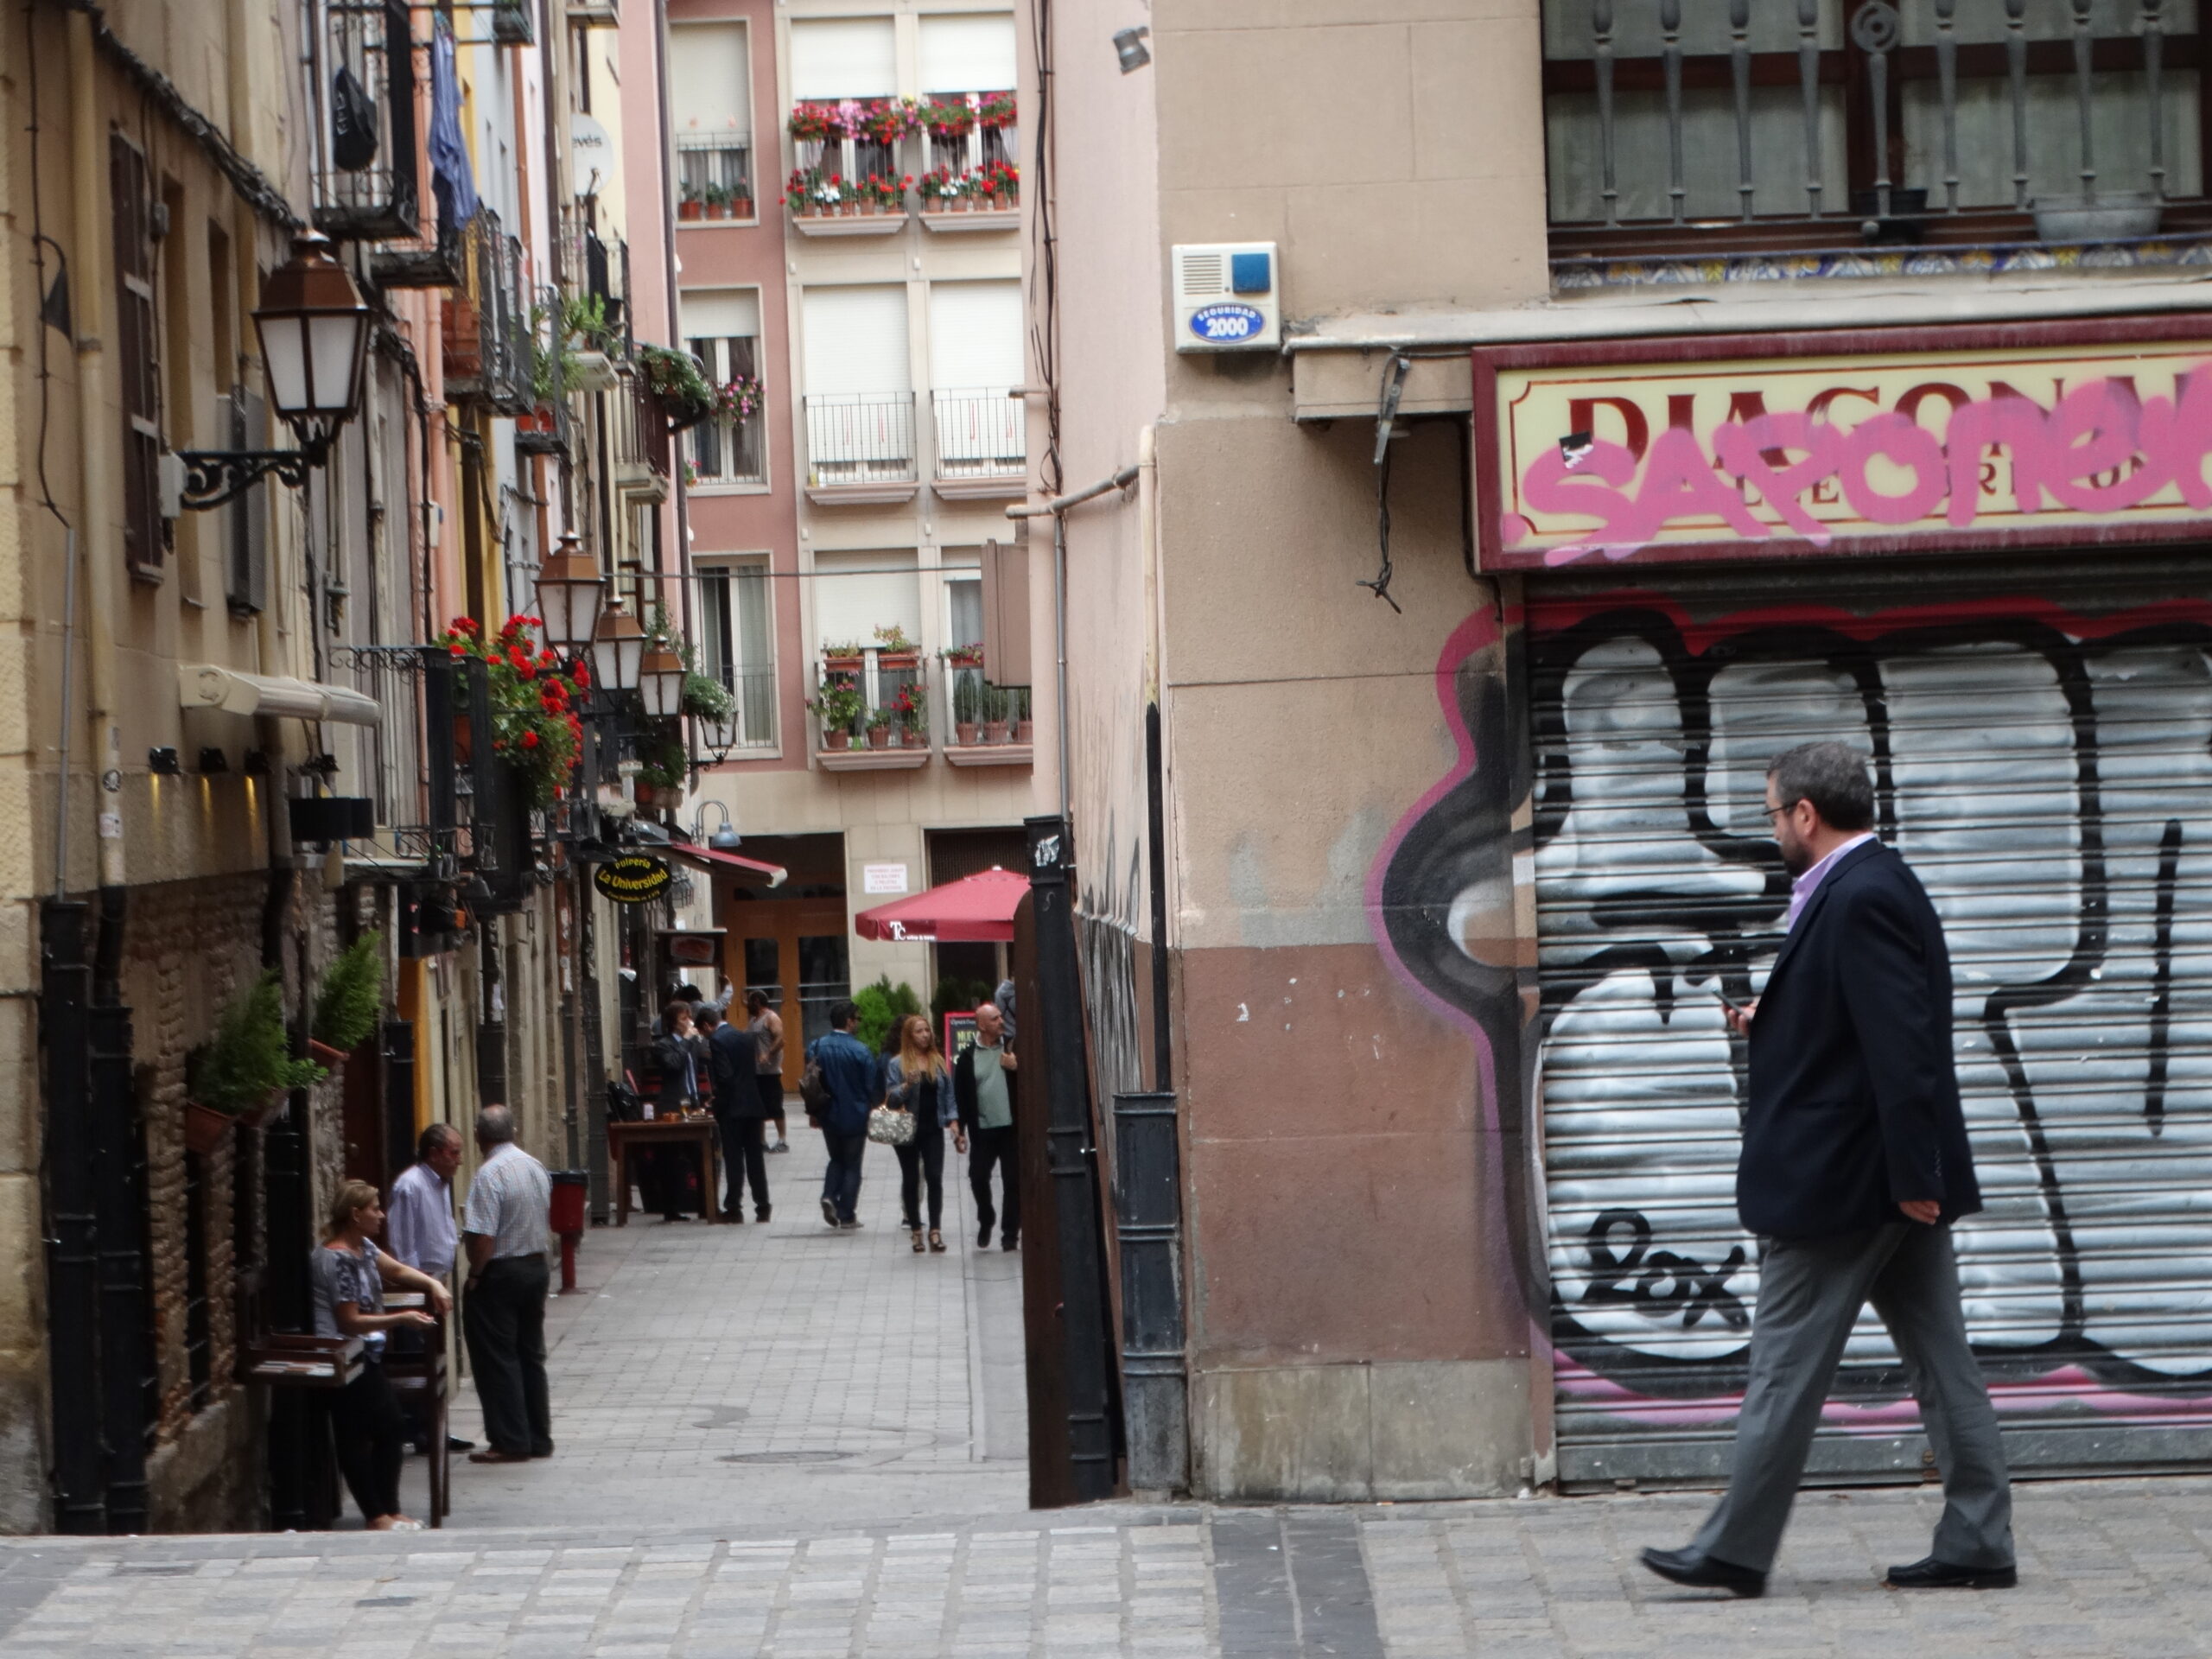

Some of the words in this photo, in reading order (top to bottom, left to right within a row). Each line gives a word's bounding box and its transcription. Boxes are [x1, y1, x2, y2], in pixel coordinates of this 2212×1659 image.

[1198, 307, 1256, 321] SEGURIDAD
[1206, 316, 1249, 337] 2000
[599, 869, 611, 884] La
[612, 868, 668, 889] Universidad
